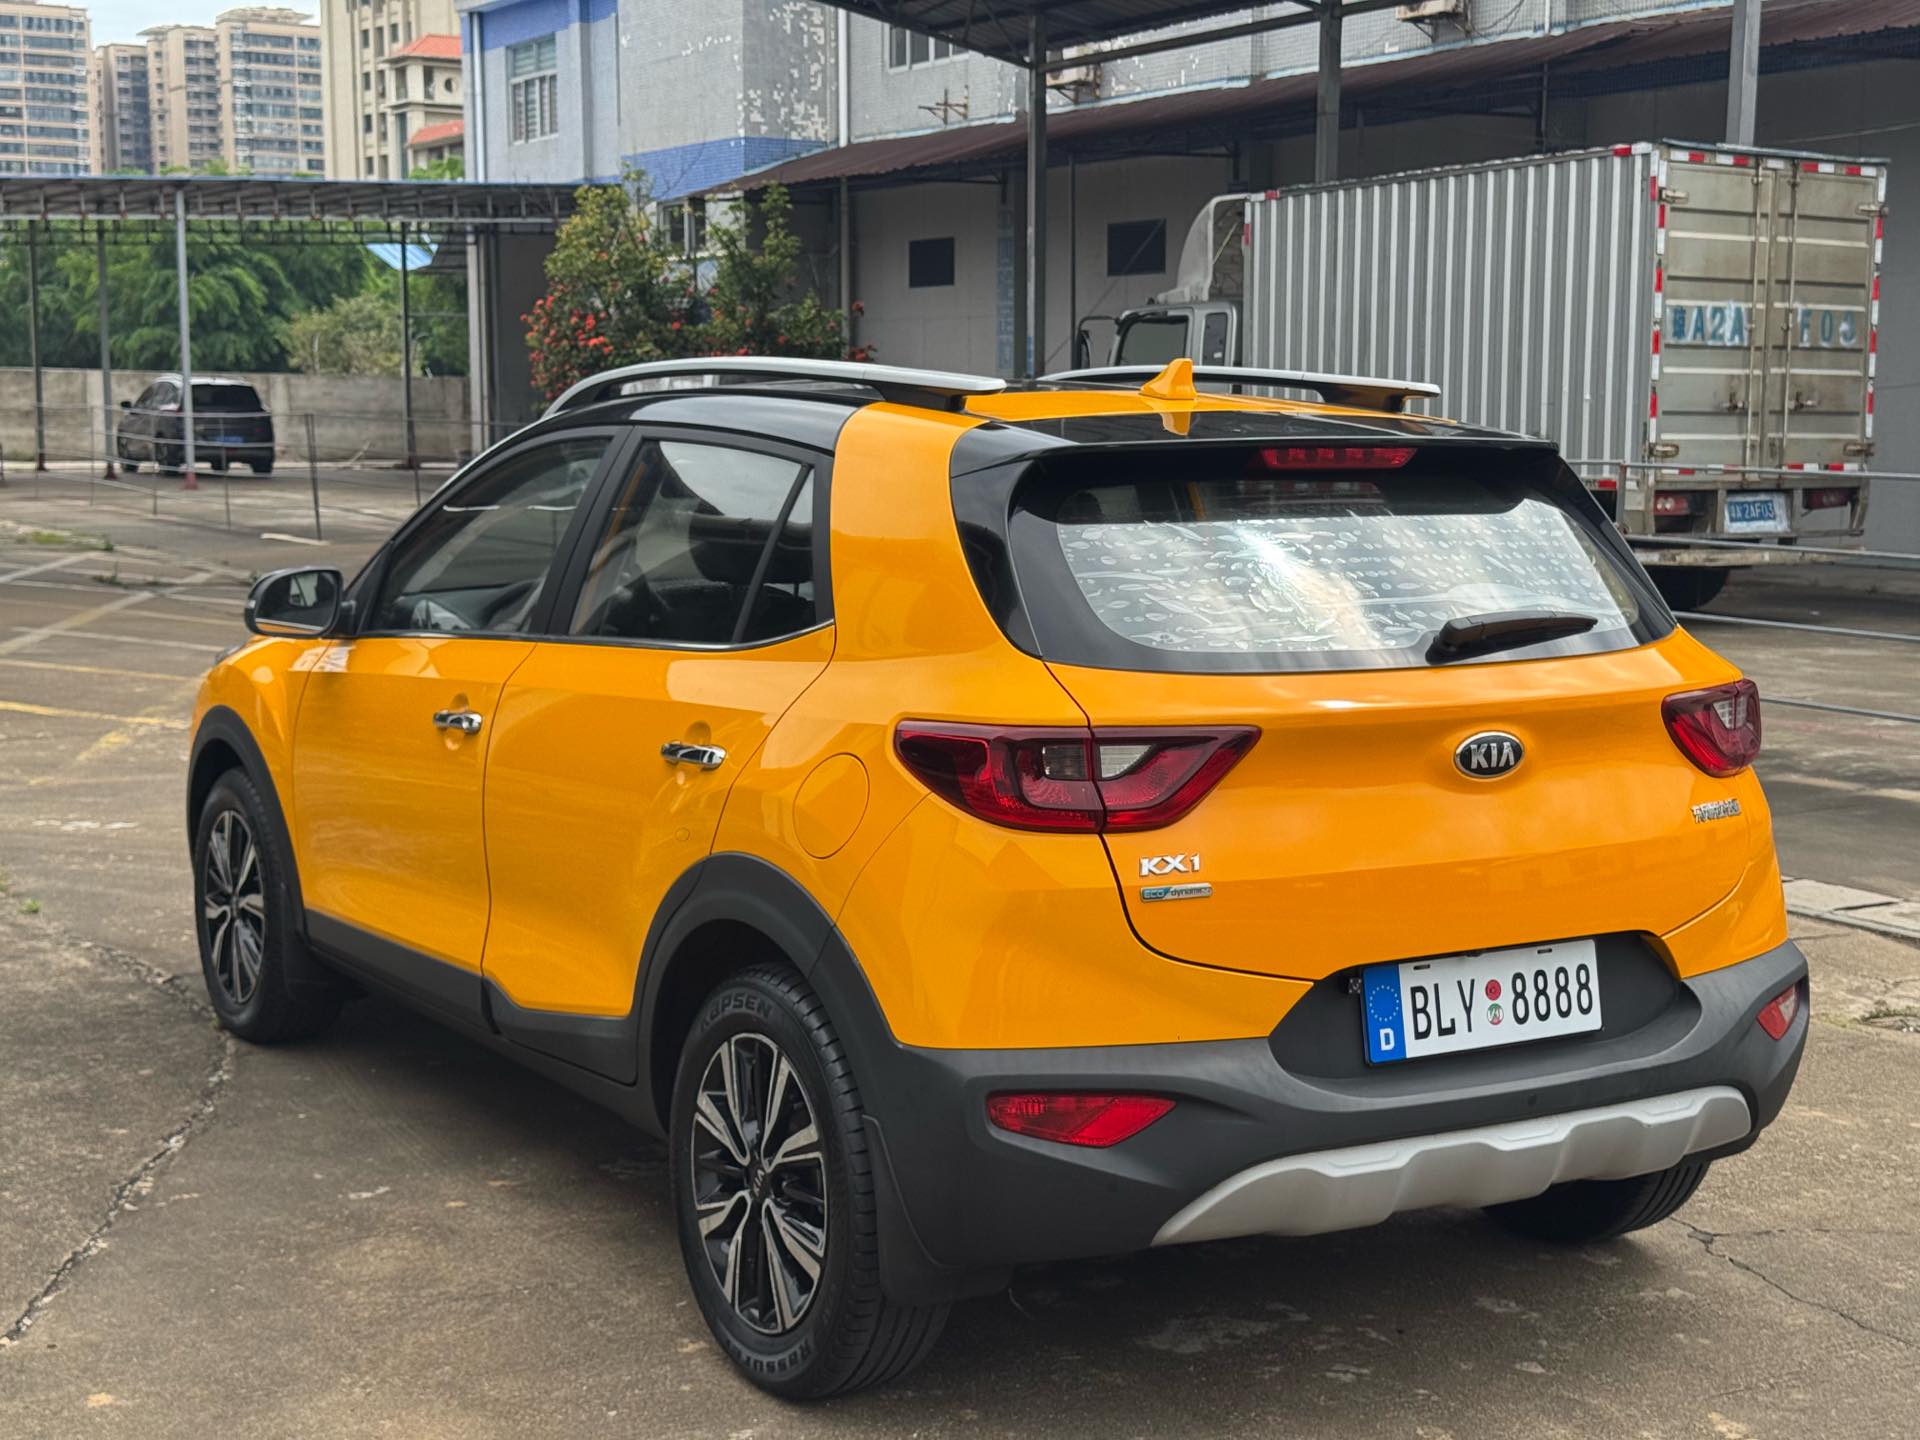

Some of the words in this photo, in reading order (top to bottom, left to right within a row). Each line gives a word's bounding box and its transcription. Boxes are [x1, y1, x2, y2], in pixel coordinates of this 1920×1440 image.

[1470, 741, 1515, 769] KIA
[1139, 853, 1200, 877] KX1
[1410, 978, 1476, 1041] BLY
[1511, 963, 1593, 1025] 8888
[1379, 1028, 1395, 1051] D
